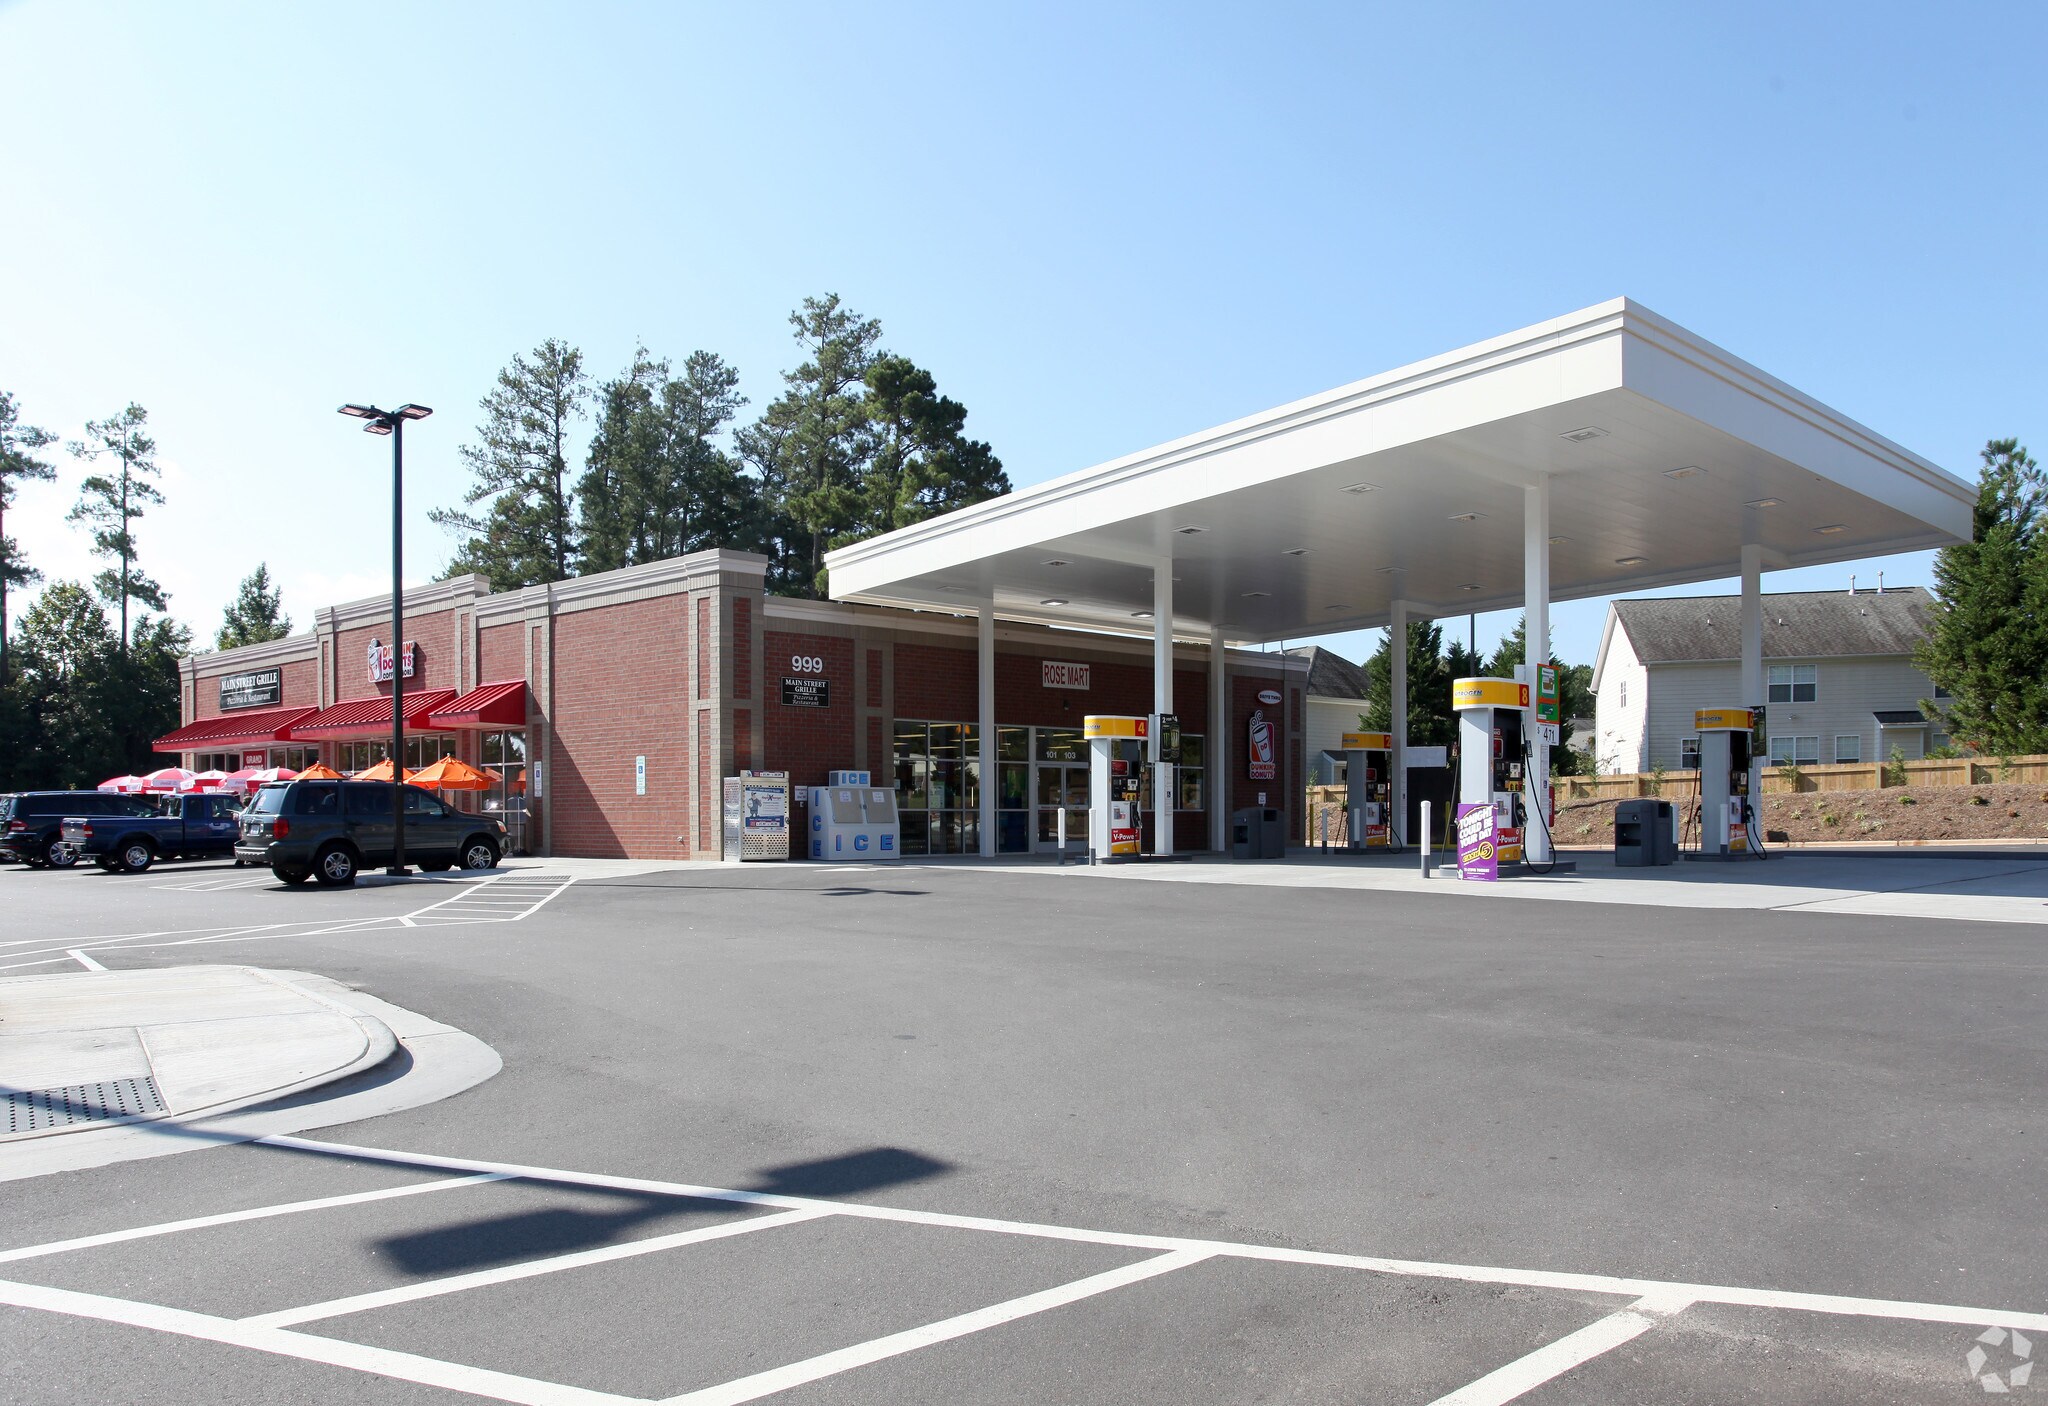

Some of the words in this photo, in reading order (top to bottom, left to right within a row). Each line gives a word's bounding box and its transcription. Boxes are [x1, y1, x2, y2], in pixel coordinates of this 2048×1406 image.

[382, 642, 413, 658] DUIN'
[382, 655, 412, 670] DOTS
[792, 656, 822, 673] 999
[222, 680, 236, 691] MAIN
[236, 676, 256, 688] STREET
[256, 672, 277, 685] GRILLE
[1044, 664, 1066, 684] ROSE
[1068, 666, 1088, 686] MART
[1522, 688, 1528, 704] 8
[1138, 722, 1145, 734] 4
[1386, 736, 1392, 747] 2
[246, 755, 263, 764] GRAND
[841, 773, 868, 784] ICE
[812, 790, 821, 856] ICE
[1460, 805, 1493, 830] TONIGHT
[1460, 822, 1482, 838] COULD
[1484, 816, 1494, 830] BE
[836, 834, 894, 851] ICE
[1460, 834, 1478, 848] YOUR
[1478, 826, 1492, 840] DAY
